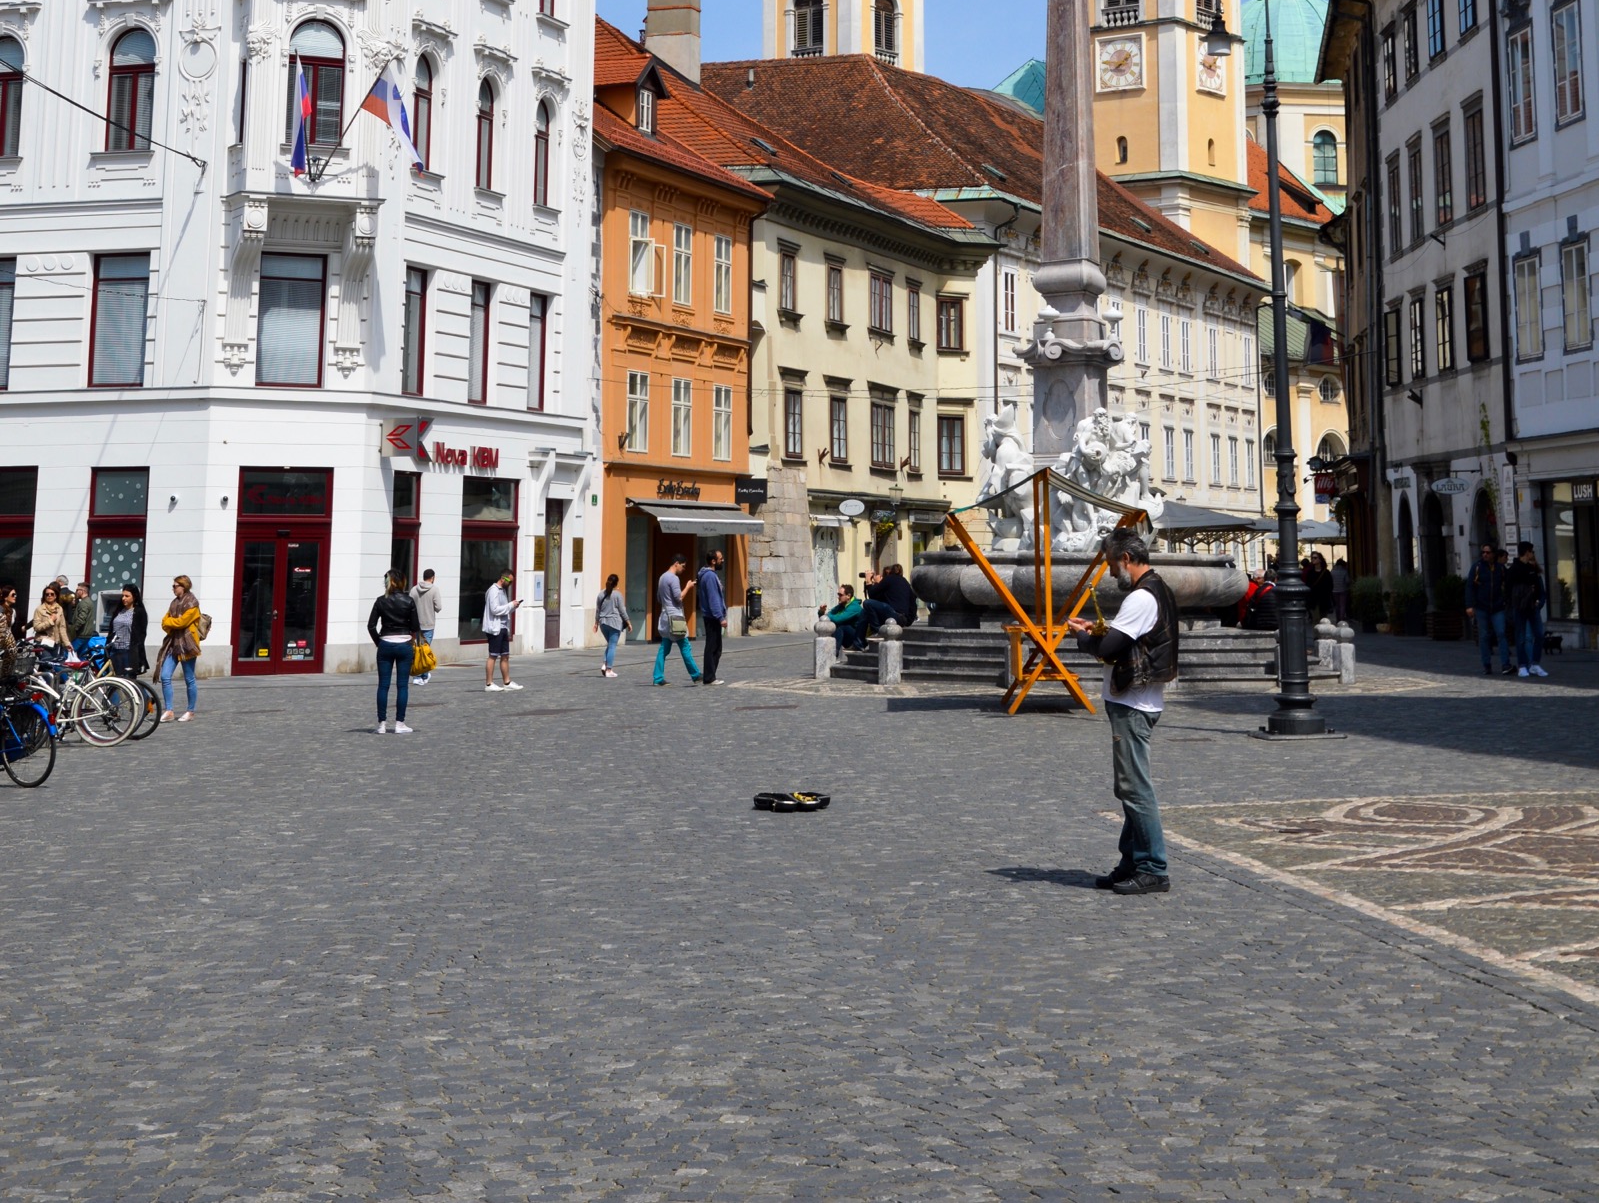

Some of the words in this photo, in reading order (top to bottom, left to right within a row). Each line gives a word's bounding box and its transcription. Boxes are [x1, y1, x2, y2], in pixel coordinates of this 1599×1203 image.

[433, 441, 467, 466] Nova
[470, 446, 499, 468] KBM
[1317, 477, 1334, 490] illy
[1436, 483, 1465, 492] LAURA
[1573, 484, 1593, 499] LUSH
